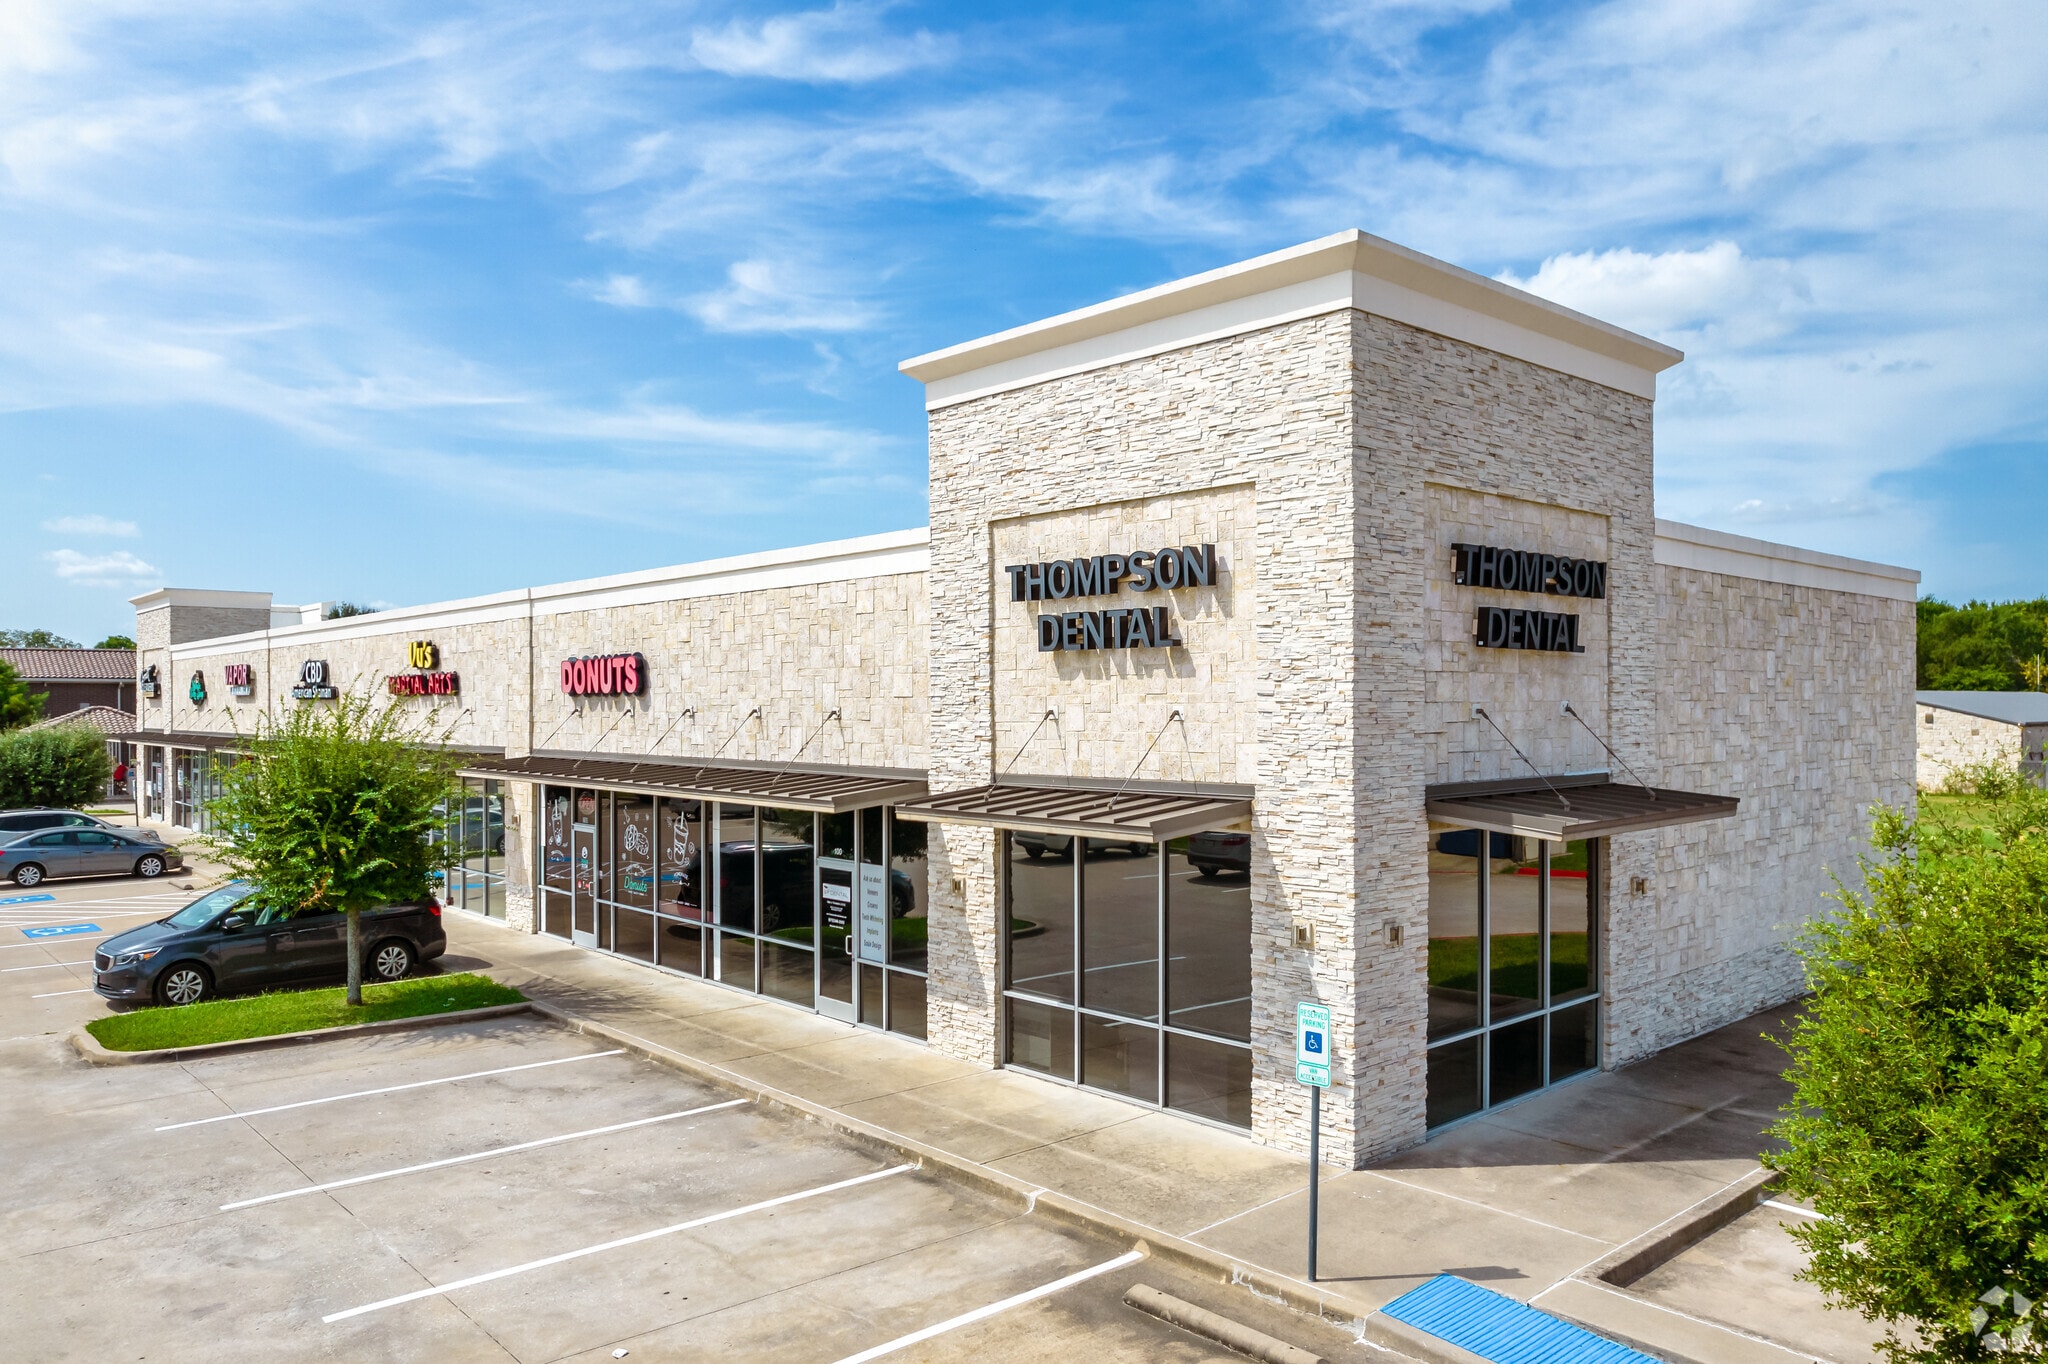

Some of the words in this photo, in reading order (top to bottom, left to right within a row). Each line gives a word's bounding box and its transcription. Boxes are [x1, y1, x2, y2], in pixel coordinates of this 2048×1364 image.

[1005, 544, 1216, 602] THOMPSON
[1452, 543, 1607, 599] THOMPSON
[1038, 607, 1181, 652] DENTAL
[1479, 607, 1585, 653] DENTAL
[408, 641, 434, 669] Vu's
[224, 664, 247, 685] VAPOR
[305, 661, 323, 683] CBD
[561, 655, 640, 695] DONUTS
[388, 675, 425, 695] MARTIAL
[428, 673, 453, 695] ARTS
[624, 876, 648, 892] Donuts
[1300, 1009, 1328, 1021] RESERVED
[1302, 1018, 1325, 1029] PARKING
[1300, 1073, 1327, 1084] ACCESSIBLE
